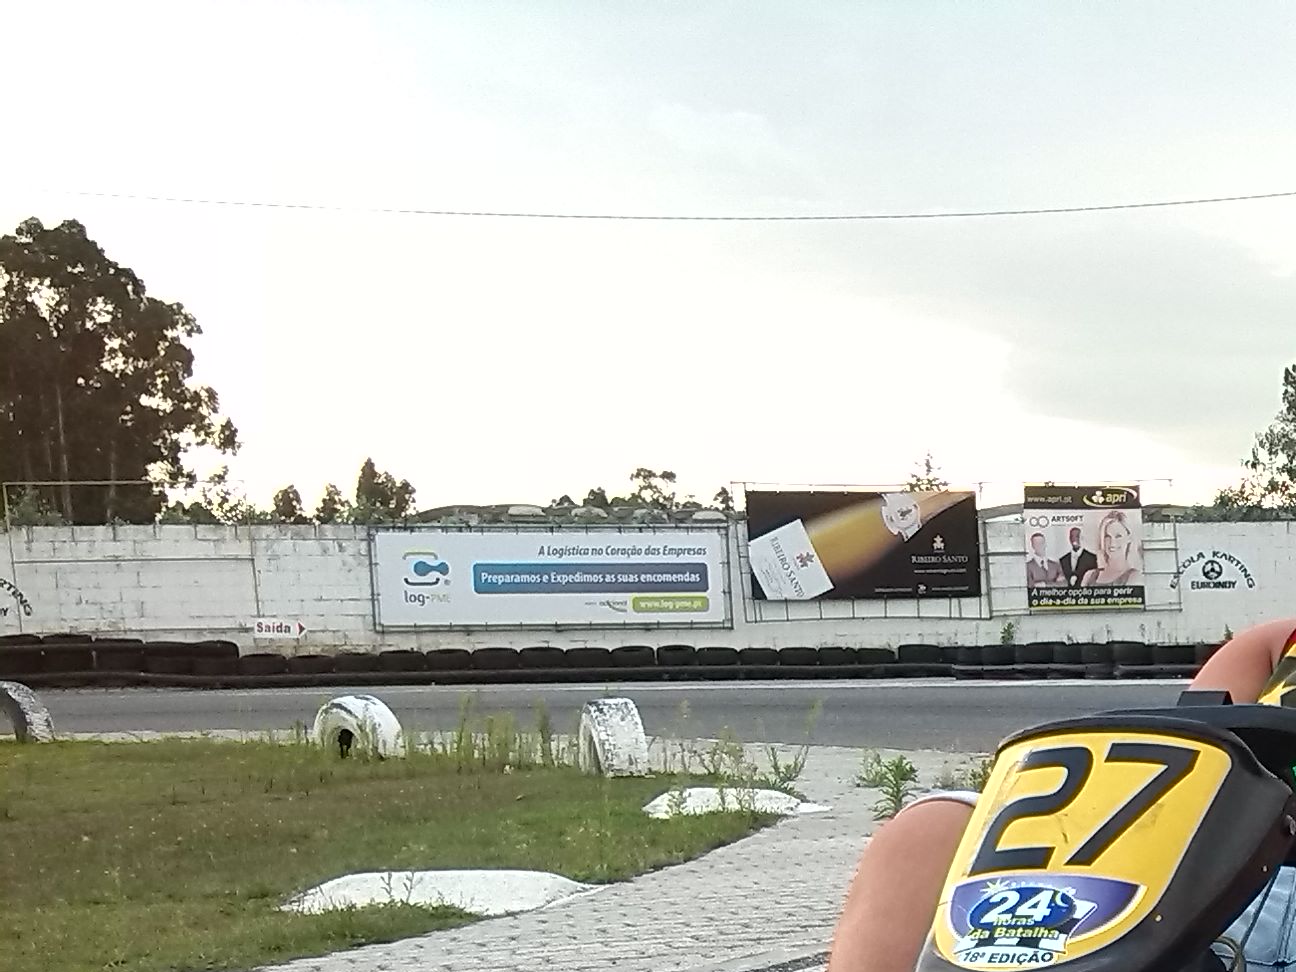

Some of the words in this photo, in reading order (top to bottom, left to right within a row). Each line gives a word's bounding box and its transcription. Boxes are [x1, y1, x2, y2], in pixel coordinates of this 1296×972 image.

[1106, 492, 1127, 504] apri
[538, 545, 545, 555] A
[605, 545, 642, 558] Coração
[644, 545, 660, 555] das
[662, 545, 706, 558] Empresas
[942, 554, 968, 562] SANTO
[1170, 551, 1205, 589] ESCOLA
[1212, 551, 1255, 589] KARTING
[481, 572, 541, 585] Preparamos
[542, 575, 548, 583] e
[550, 572, 603, 585] Expedimos
[605, 574, 616, 582] as
[617, 574, 639, 582] suas
[640, 571, 700, 582] encomendas
[1190, 580, 1237, 590] EUROINDY
[1031, 588, 1038, 596] A
[1040, 588, 1067, 596] melhor
[1068, 588, 1092, 598] opção
[1094, 589, 1111, 597] para
[1113, 588, 1133, 597] gerir
[1107, 597, 1142, 606] empresa
[968, 742, 1200, 876] 27
[980, 890, 1054, 924] 24
[970, 930, 990, 940] da
[993, 927, 1060, 940] Batalha
[988, 950, 1054, 965] EDIÇÃO
